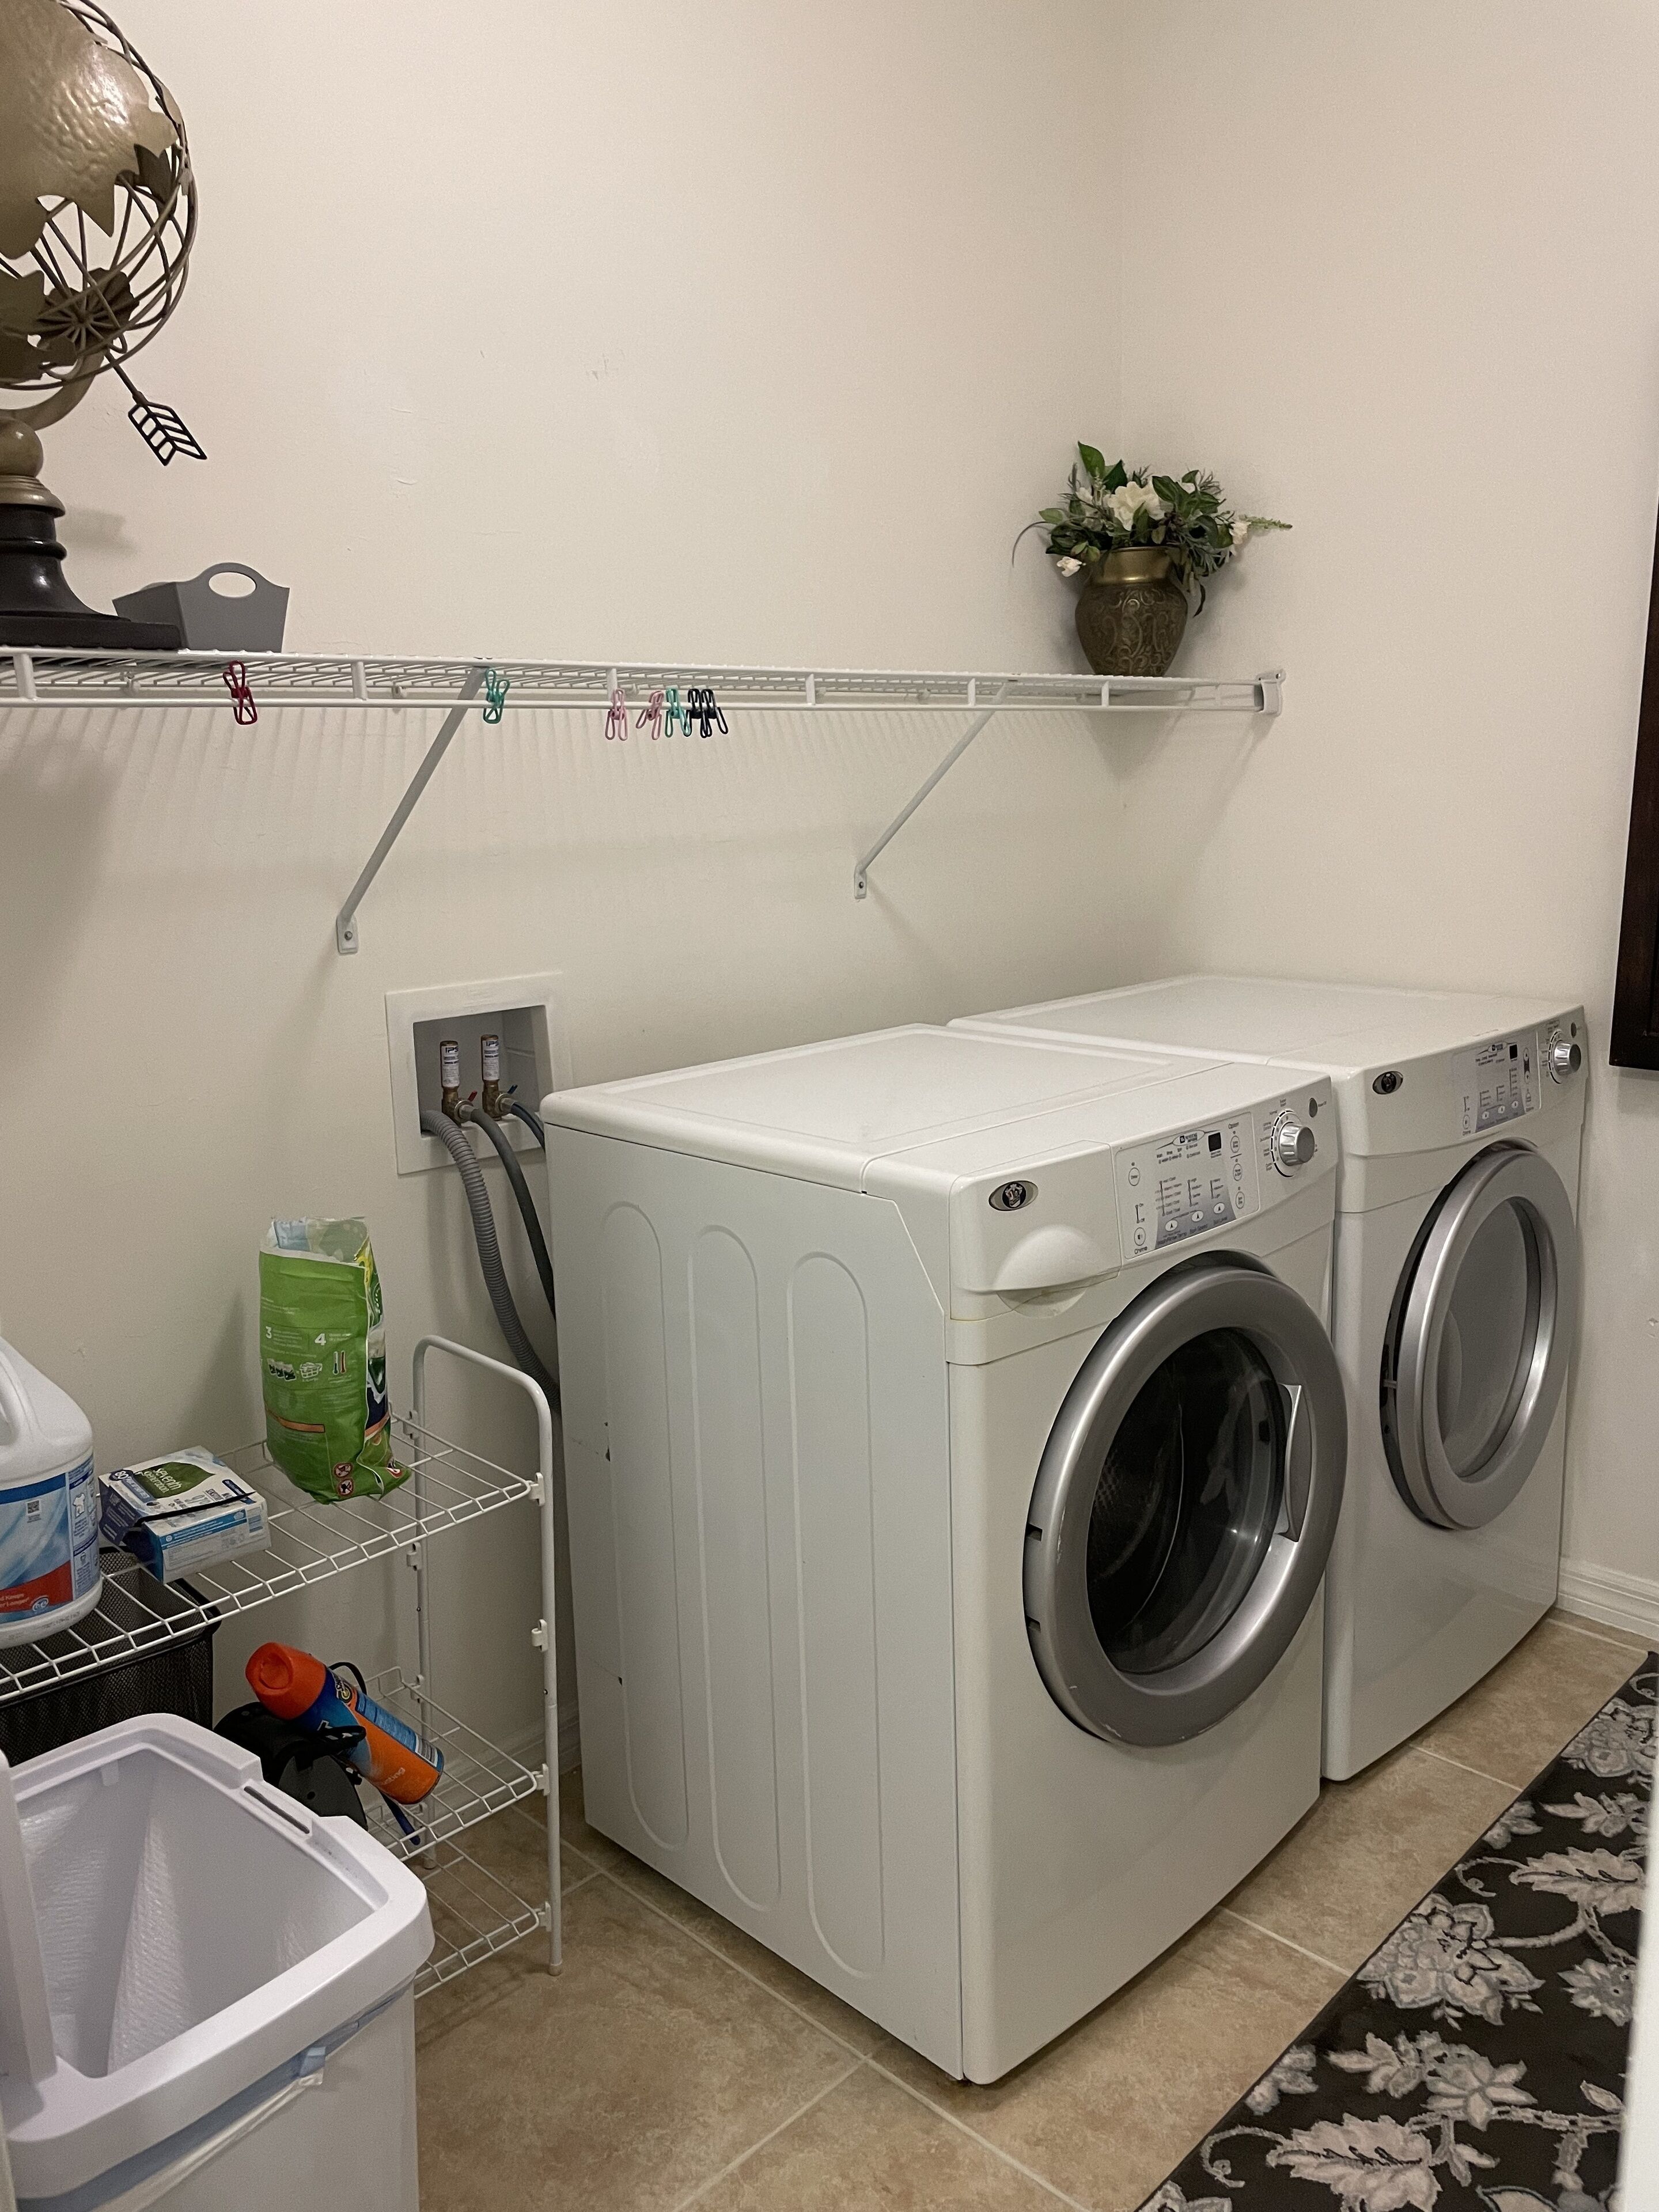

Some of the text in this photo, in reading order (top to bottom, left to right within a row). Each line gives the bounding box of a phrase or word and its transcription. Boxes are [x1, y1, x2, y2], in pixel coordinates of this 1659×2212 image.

[266, 1326, 272, 1339] 3
[315, 1333, 326, 1346] 4
[153, 1468, 183, 1490] seventh
